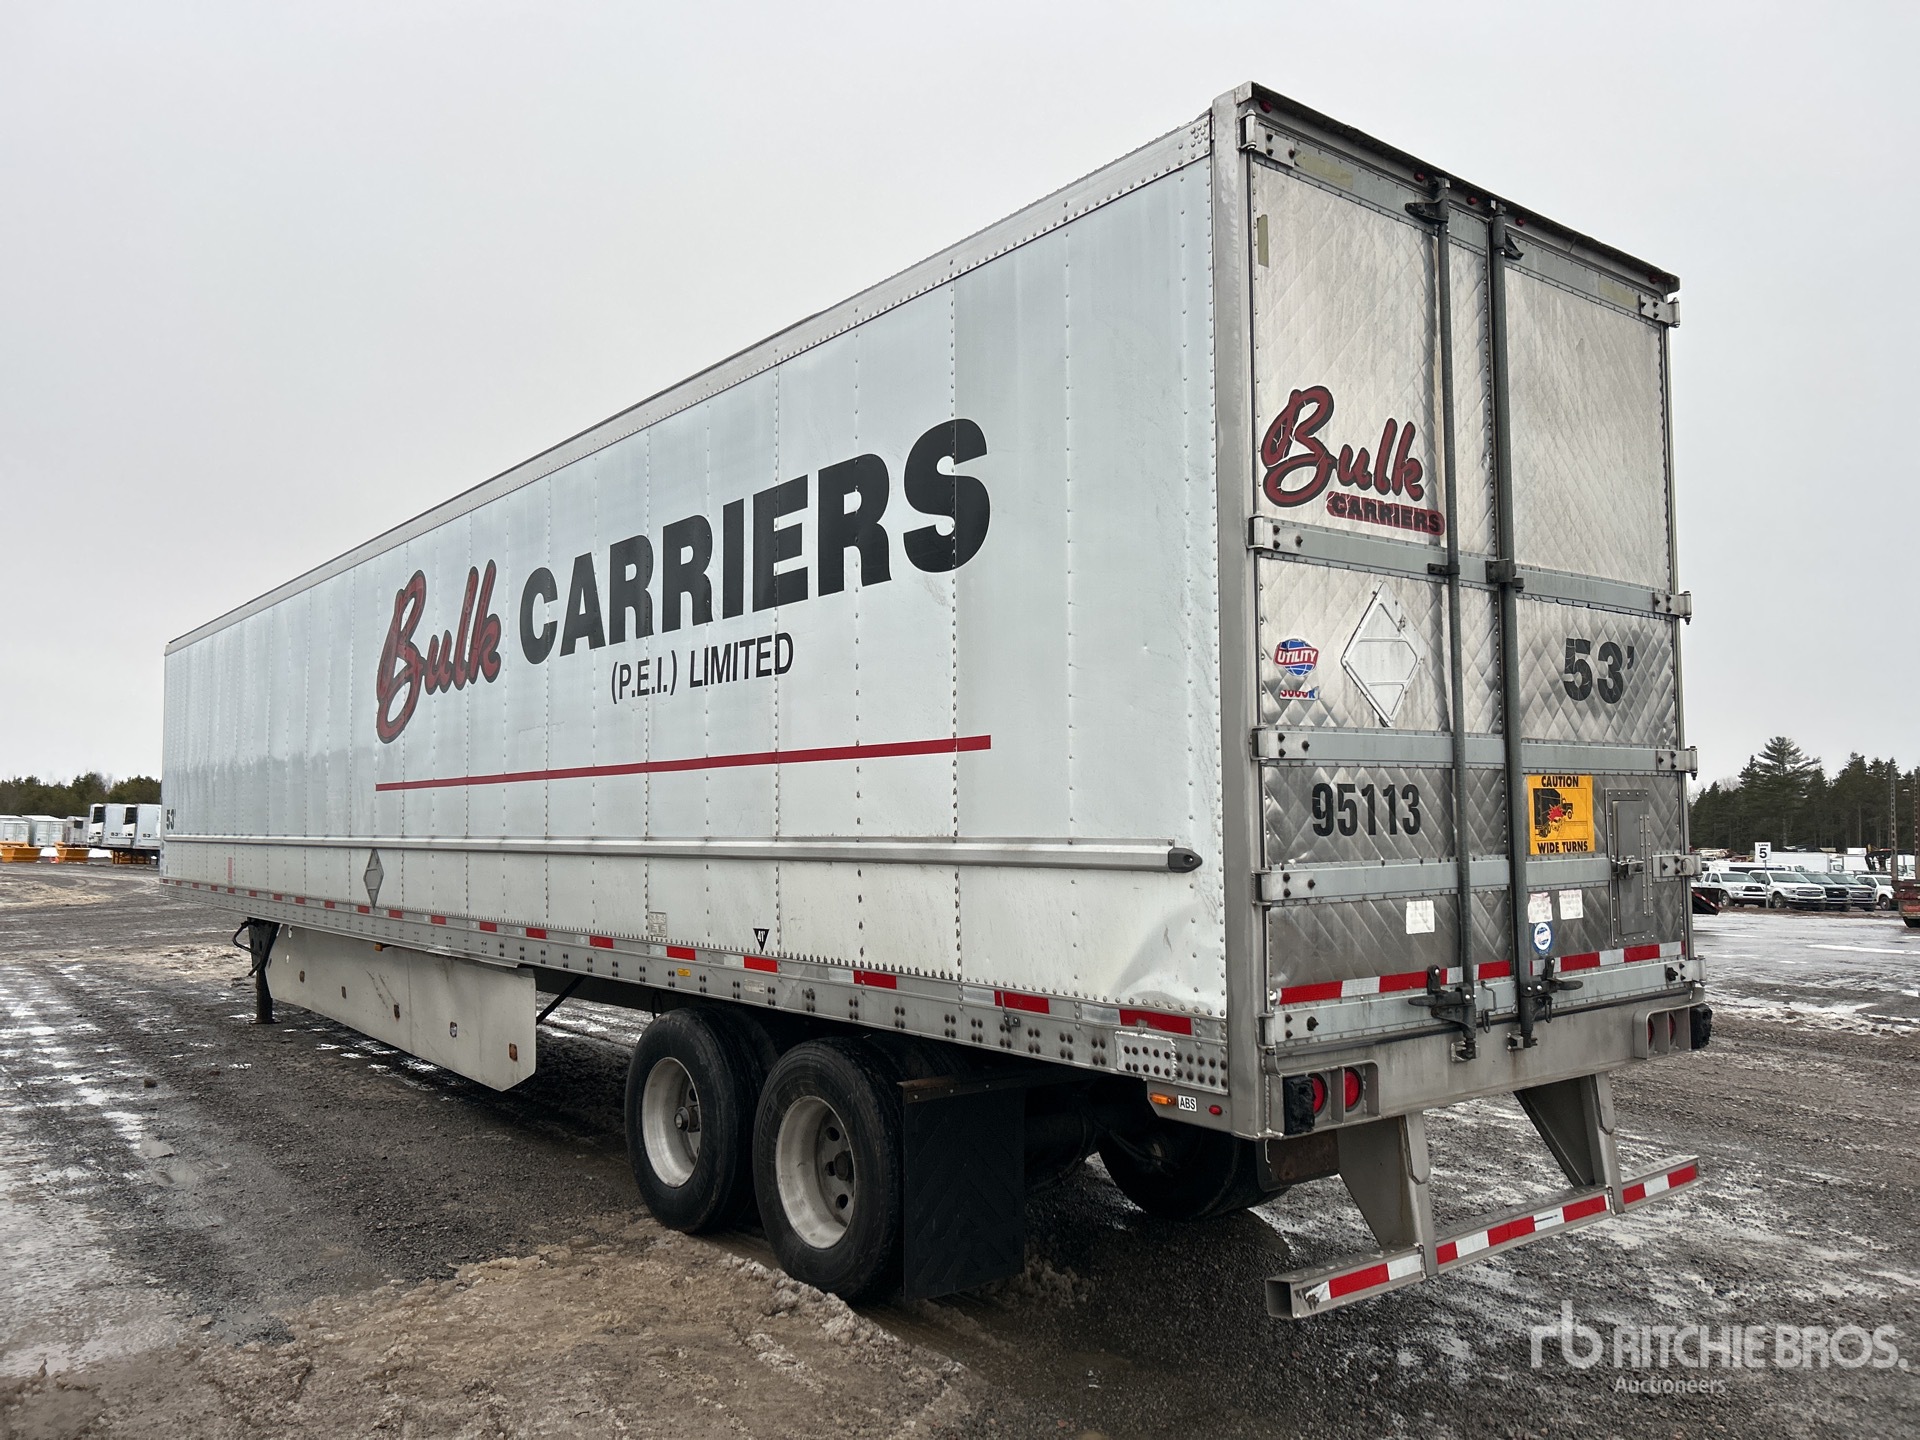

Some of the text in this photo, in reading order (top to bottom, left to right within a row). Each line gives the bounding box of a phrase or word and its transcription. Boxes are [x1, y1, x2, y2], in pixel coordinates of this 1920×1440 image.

[1261, 385, 1424, 507] Bulk
[1332, 494, 1442, 533] CARRIERS
[376, 418, 991, 744] Bulk CARRIERS
[611, 631, 794, 704] (P.E.I.) LIMITED
[1277, 650, 1317, 663] UTILITY
[1563, 638, 1634, 704] 53'
[1541, 776, 1579, 787] CAUTION
[1312, 783, 1421, 836] 95113
[1537, 841, 1588, 854] WIDE TURNS
[1759, 847, 1767, 858] 5
[1180, 1097, 1196, 1109] ABS
